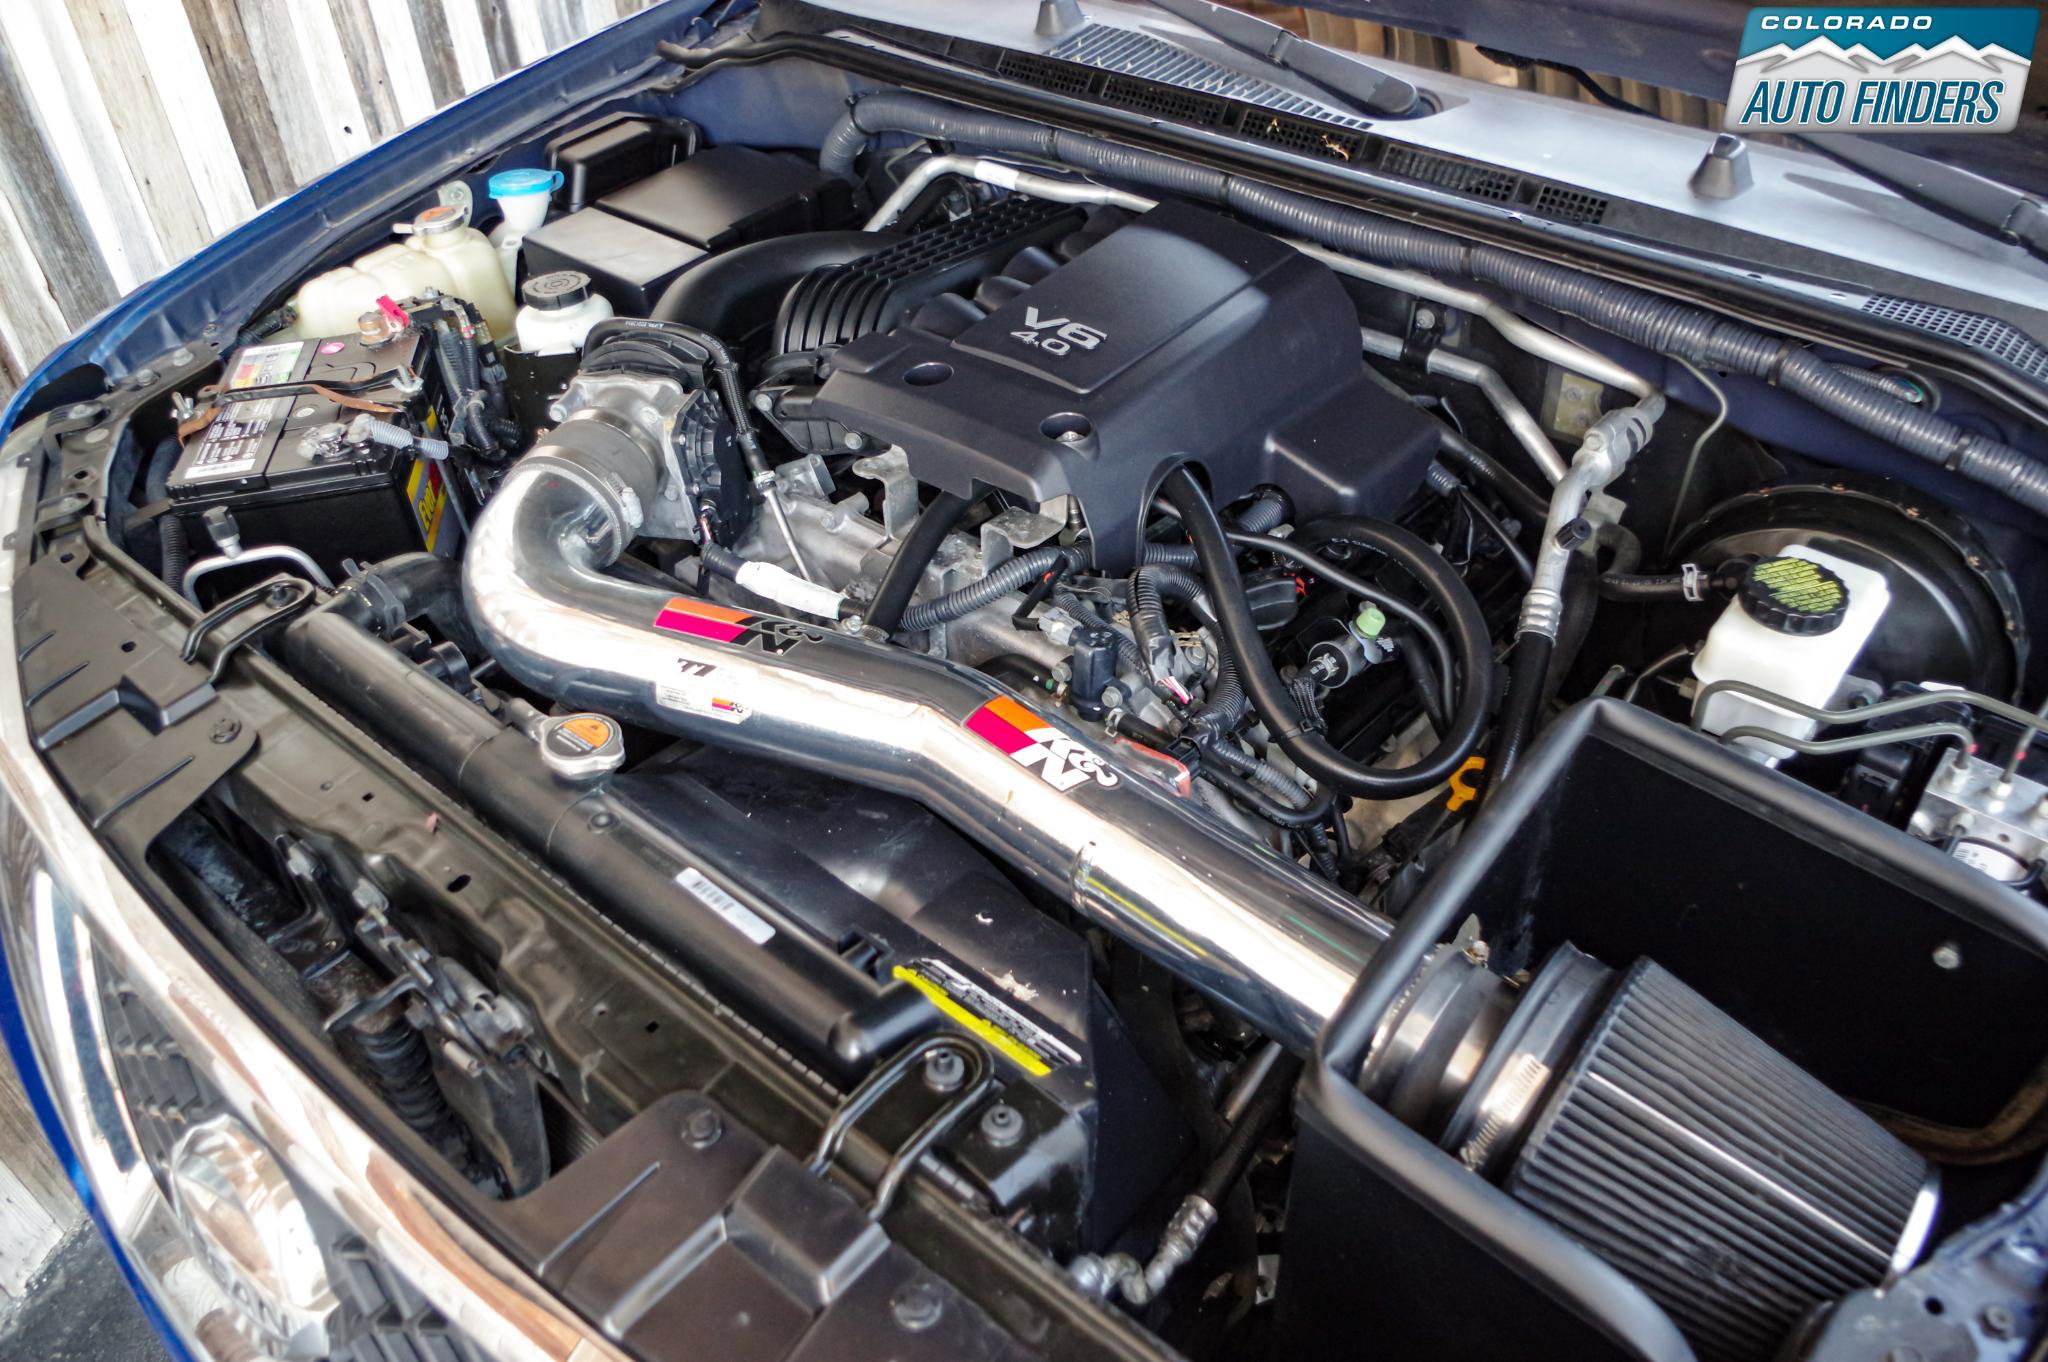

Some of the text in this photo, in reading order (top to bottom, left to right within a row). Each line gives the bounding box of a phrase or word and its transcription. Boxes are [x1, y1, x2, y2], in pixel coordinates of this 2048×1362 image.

[1010, 331, 1070, 356] 4.0
[1025, 306, 1108, 349] V6
[678, 658, 717, 677] 77
[1010, 727, 1119, 791] K&N
